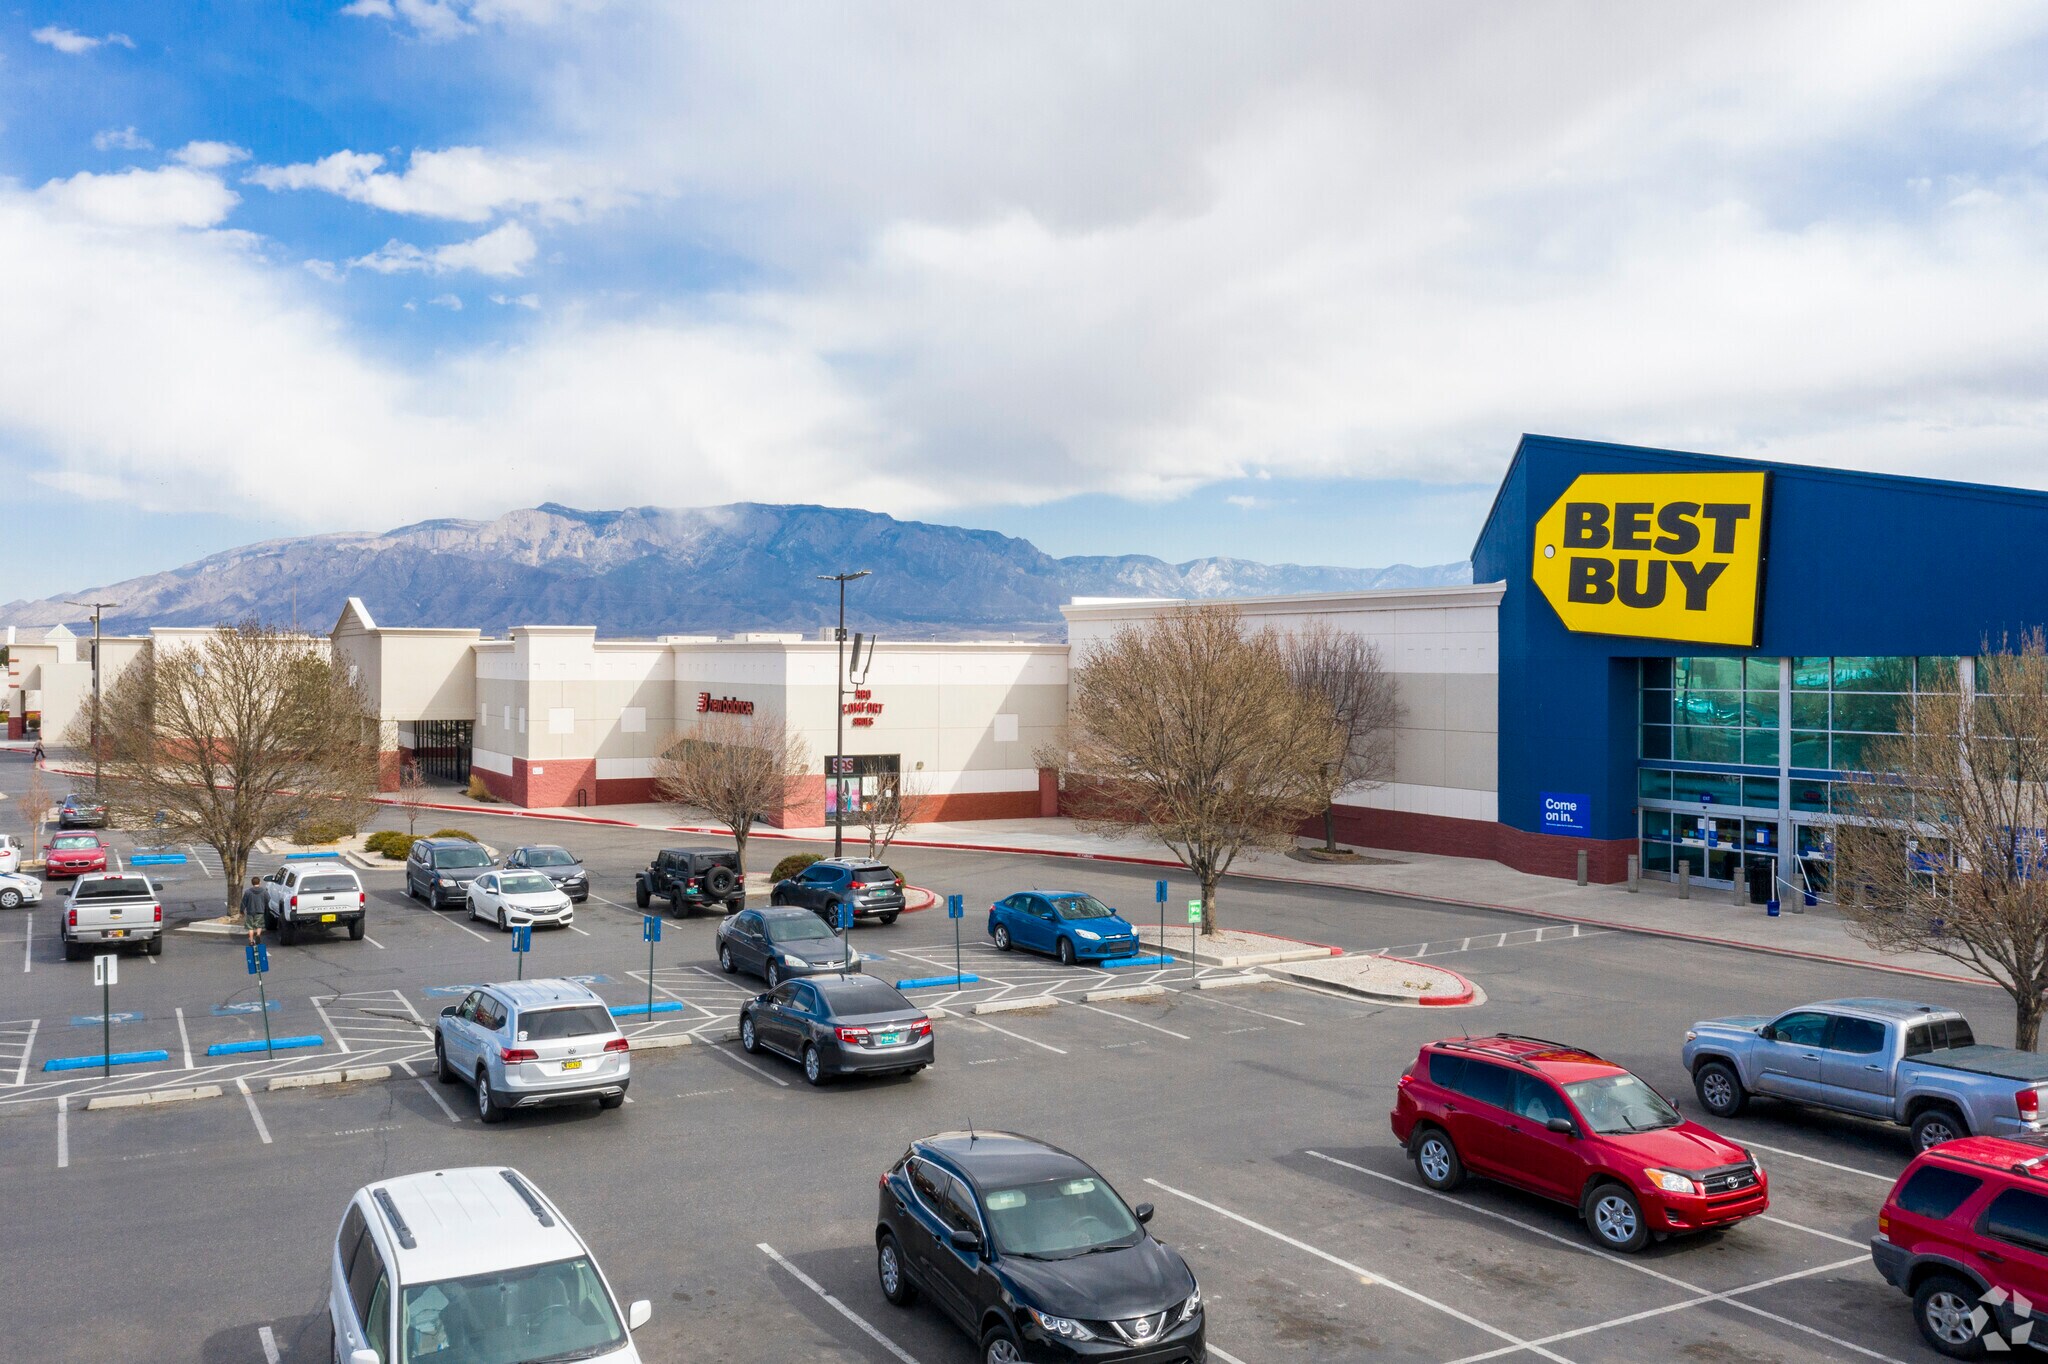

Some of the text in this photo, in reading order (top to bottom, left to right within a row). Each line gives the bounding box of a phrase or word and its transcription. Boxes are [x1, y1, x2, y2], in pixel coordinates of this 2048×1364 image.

[1563, 502, 1751, 555] BEST
[1567, 556, 1729, 611] BUY
[842, 702, 884, 715] COMFORT
[1545, 798, 1577, 811] Come
[1545, 810, 1573, 822] on in.
